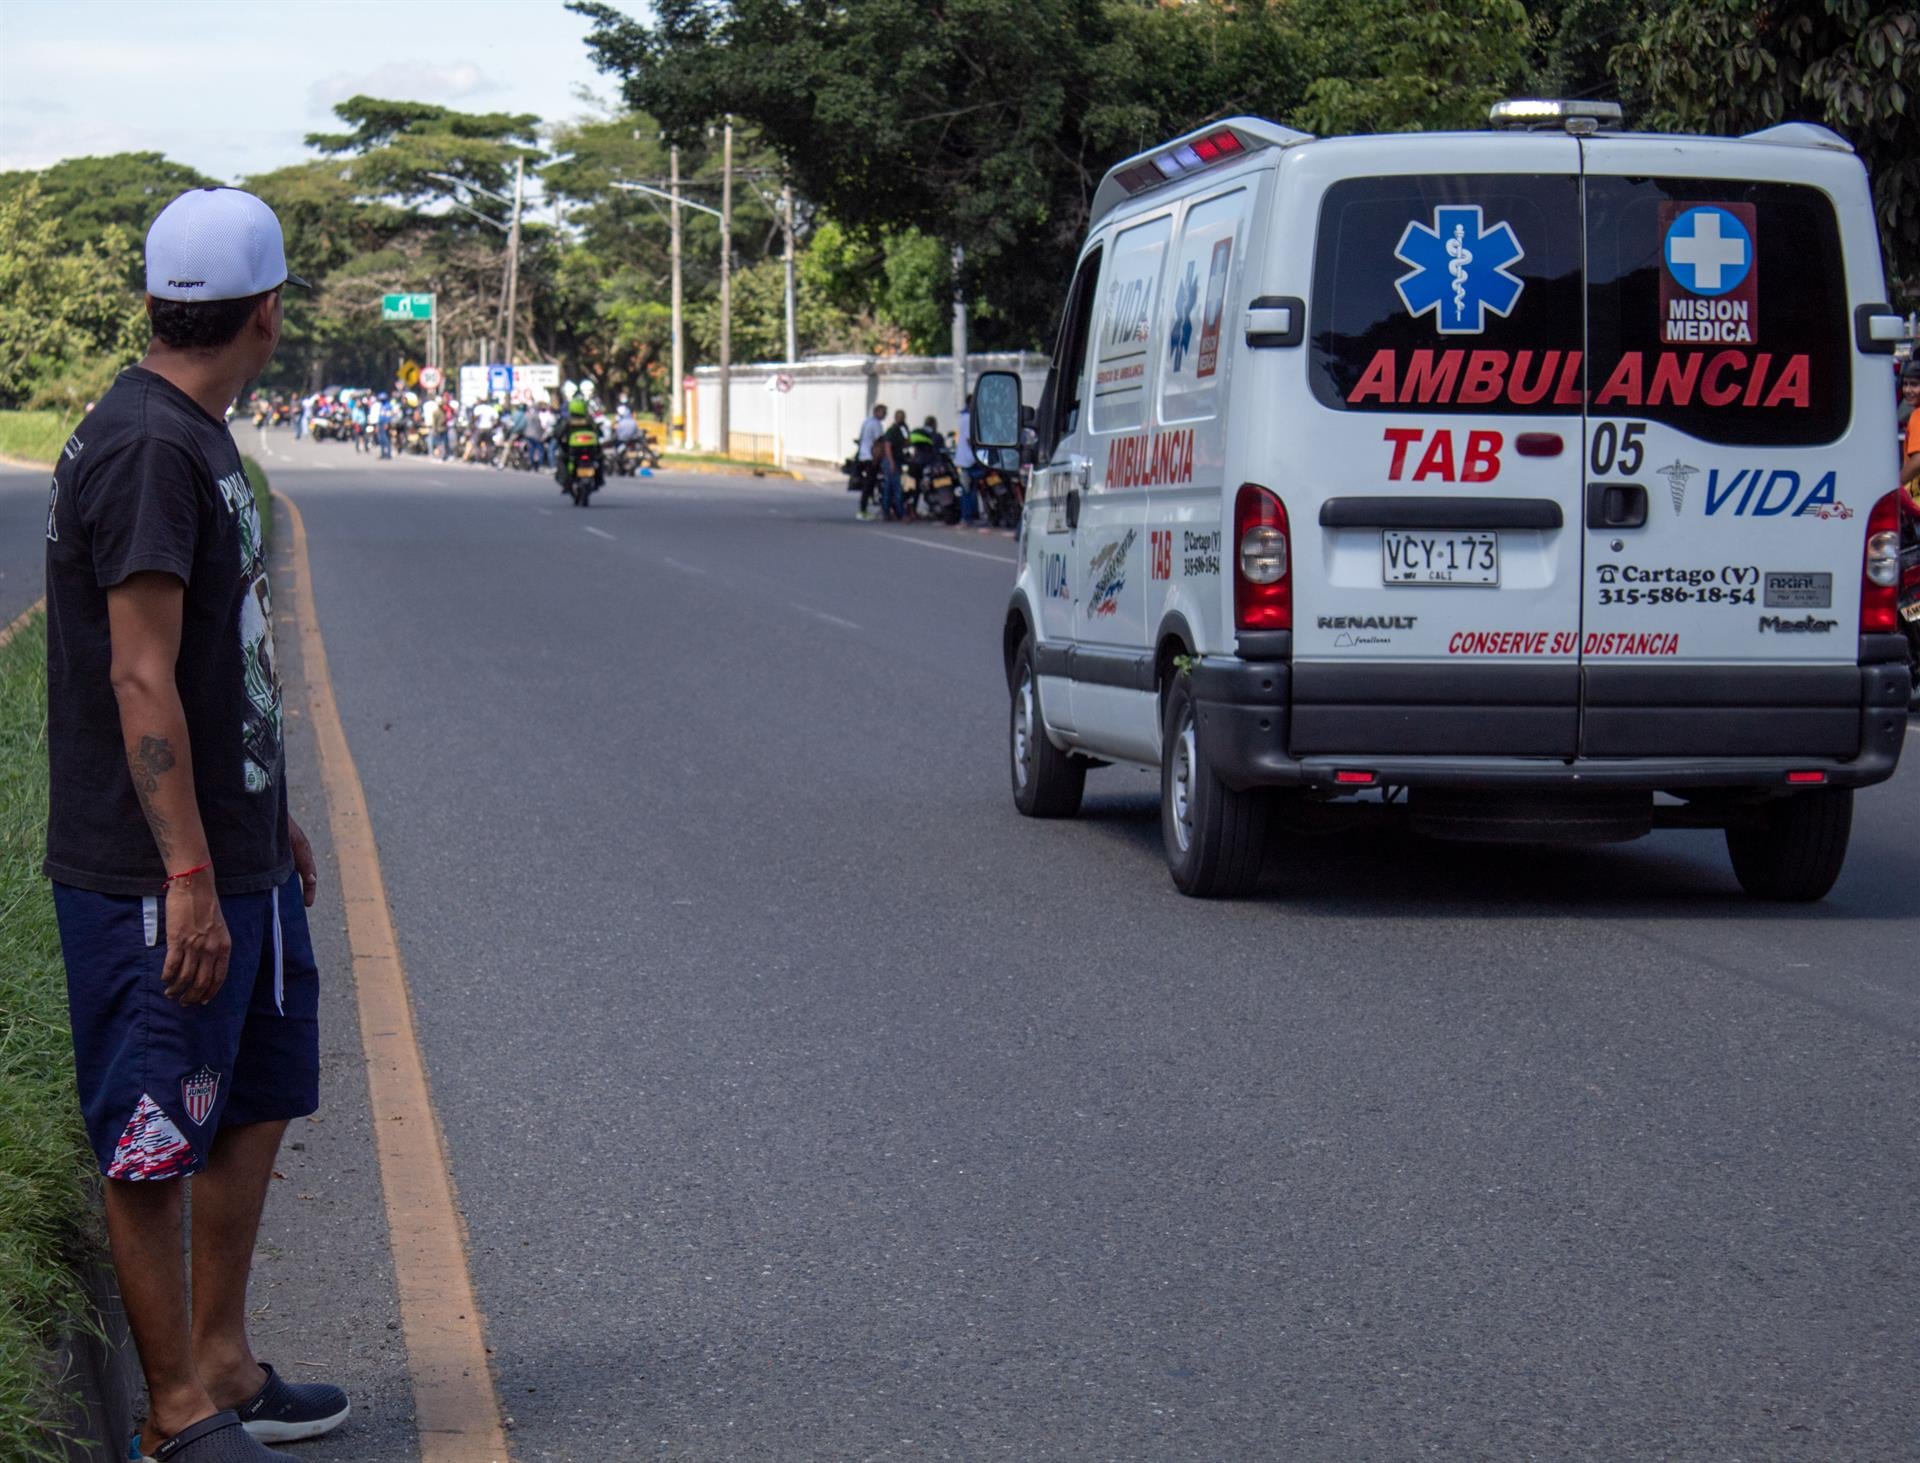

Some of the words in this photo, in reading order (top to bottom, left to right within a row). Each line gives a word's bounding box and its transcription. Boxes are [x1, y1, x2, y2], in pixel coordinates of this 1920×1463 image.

[1111, 276, 1153, 345] VIDA
[1669, 299, 1748, 320] MISION
[1666, 320, 1752, 342] MEDICA
[1347, 349, 1810, 407] AMBULANCIA
[1105, 429, 1194, 489] AMBULANCIA
[1382, 428, 1504, 483] TAB
[1590, 422, 1646, 476] 05
[1704, 469, 1837, 517] VIDA
[1151, 530, 1171, 580] TAB
[1045, 553, 1067, 597] VIDA
[1428, 571, 1453, 580] CALI
[1622, 565, 1716, 586] Cartago
[1720, 565, 1760, 585] (V)
[1598, 587, 1756, 605] 315-586-18-54
[1317, 616, 1418, 629] RENAULT
[1758, 614, 1838, 634] Master
[1448, 632, 1549, 654] CONSERVE
[1550, 632, 1579, 654] SU
[1583, 633, 1679, 655] DISTANCIA
[188, 1087, 211, 1096] JUNIOR
